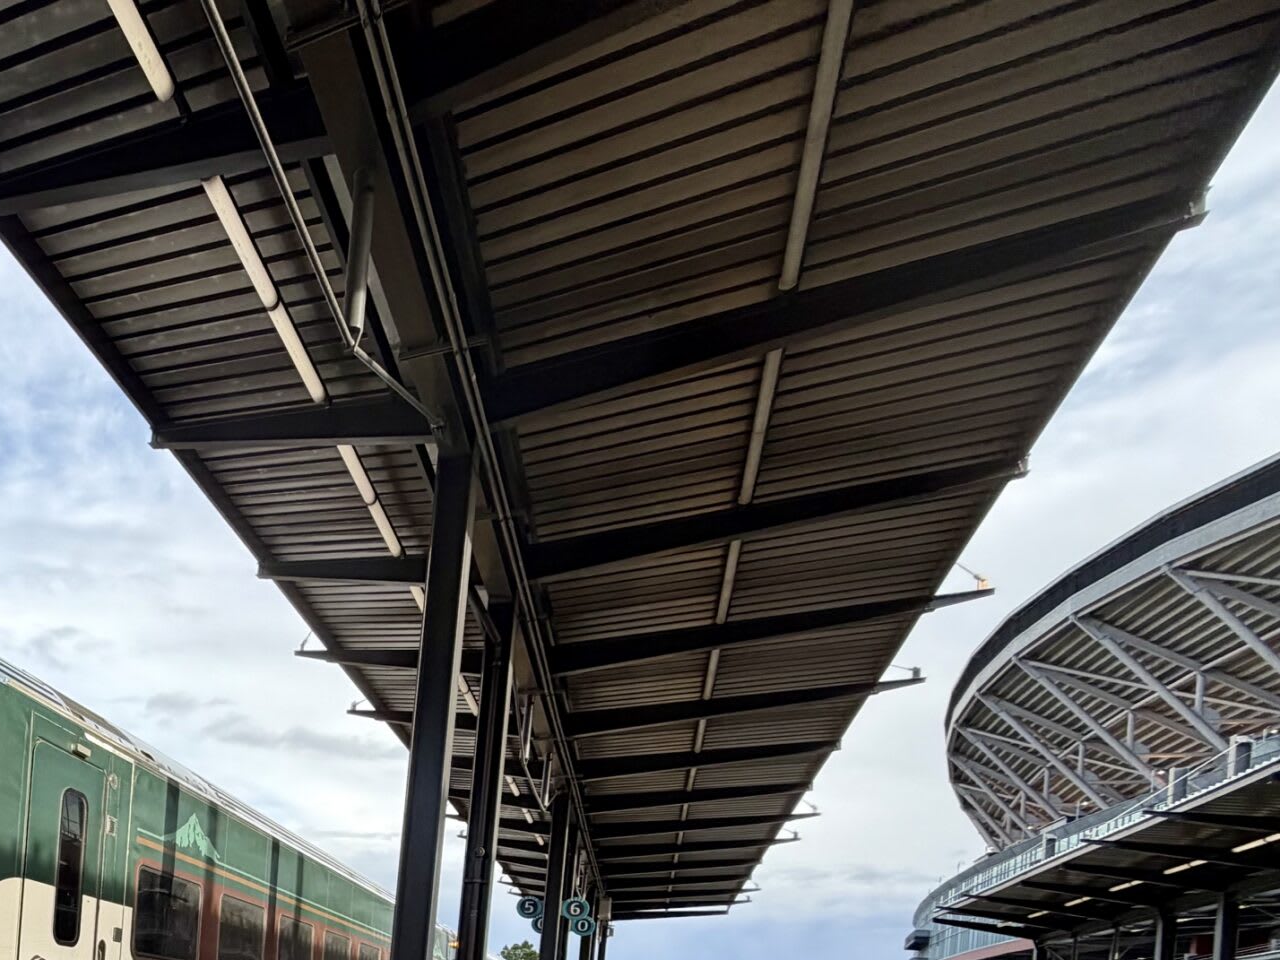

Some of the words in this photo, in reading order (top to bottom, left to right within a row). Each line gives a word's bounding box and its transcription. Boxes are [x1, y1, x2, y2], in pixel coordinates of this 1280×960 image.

[523, 901, 535, 913] 5
[570, 902, 581, 916] 6
[577, 919, 589, 932] 0
